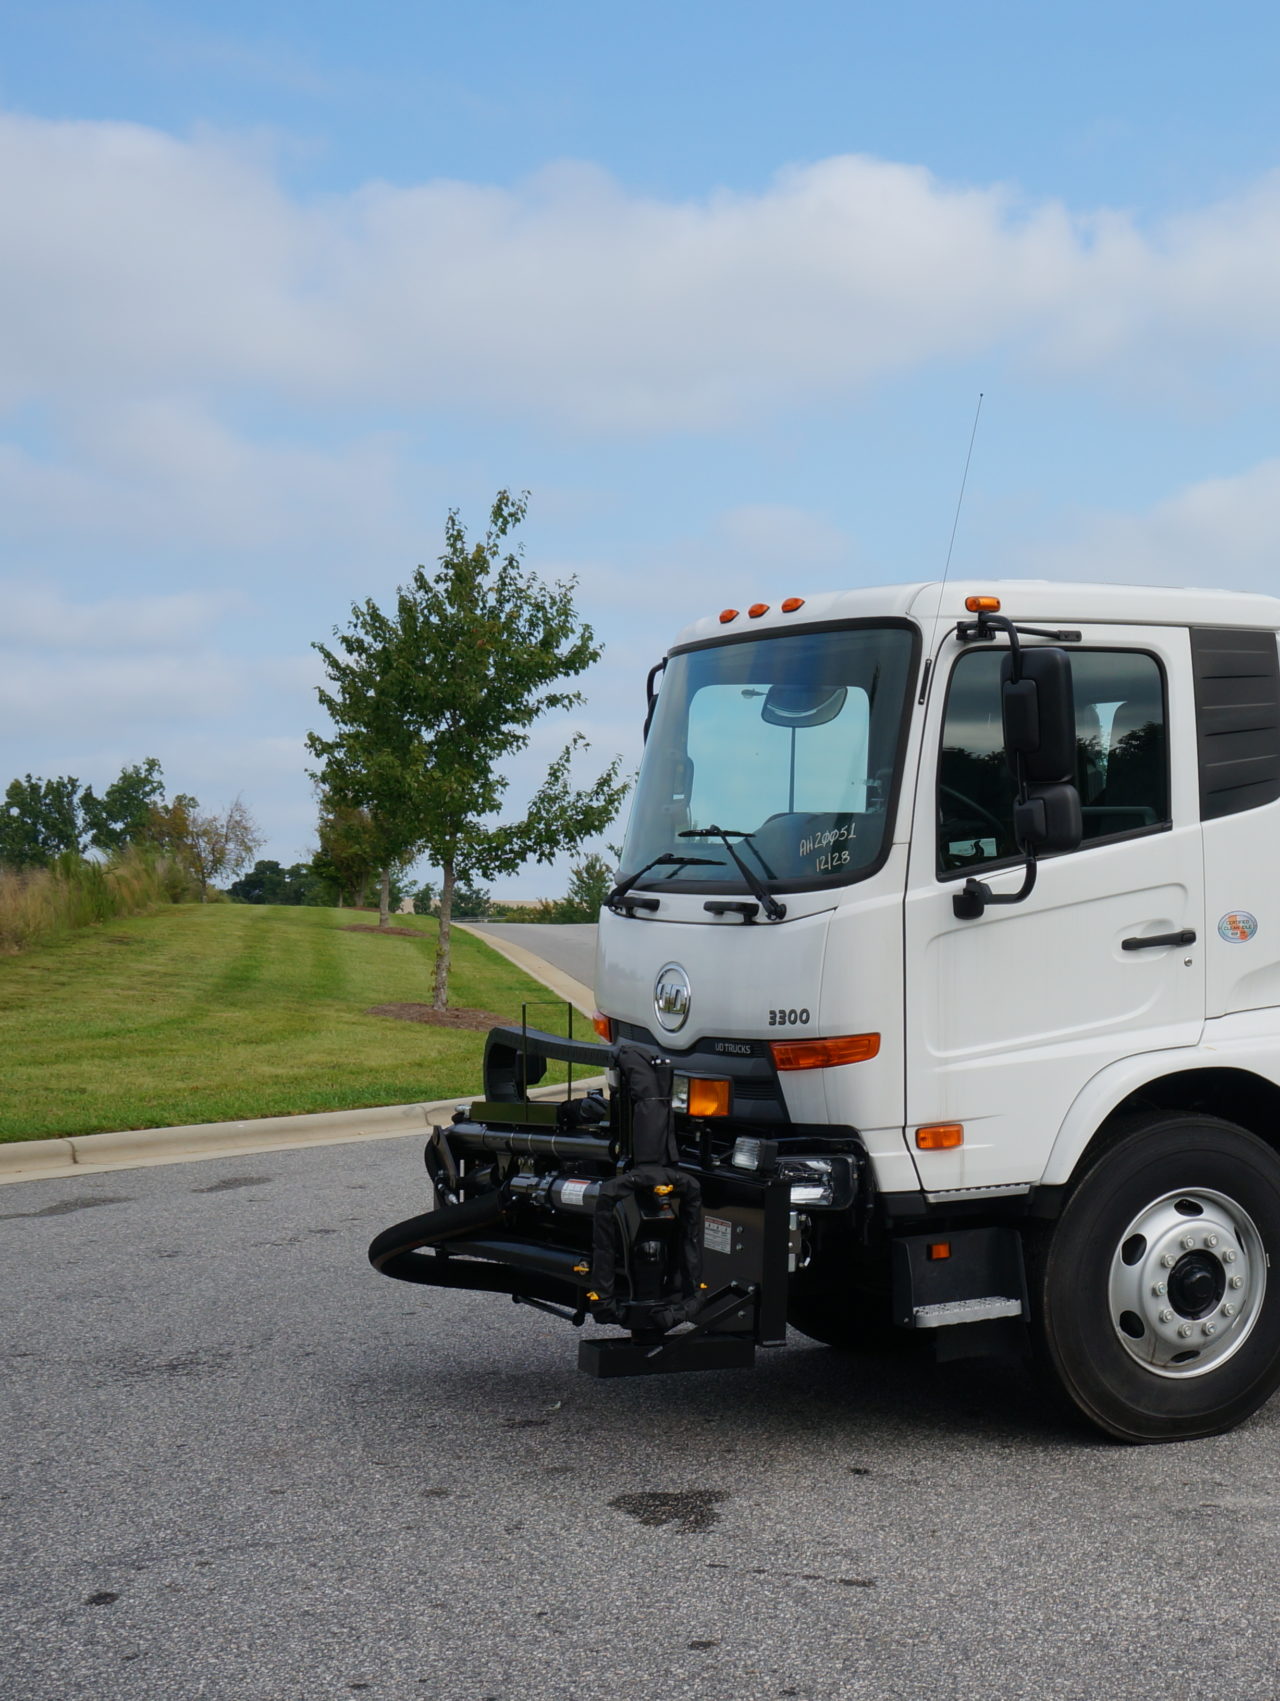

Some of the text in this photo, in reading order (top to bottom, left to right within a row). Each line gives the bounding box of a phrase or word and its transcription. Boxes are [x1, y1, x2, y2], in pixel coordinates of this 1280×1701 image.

[768, 1008, 811, 1026] 3300
[715, 1042, 751, 1054] UD TRUCKS
